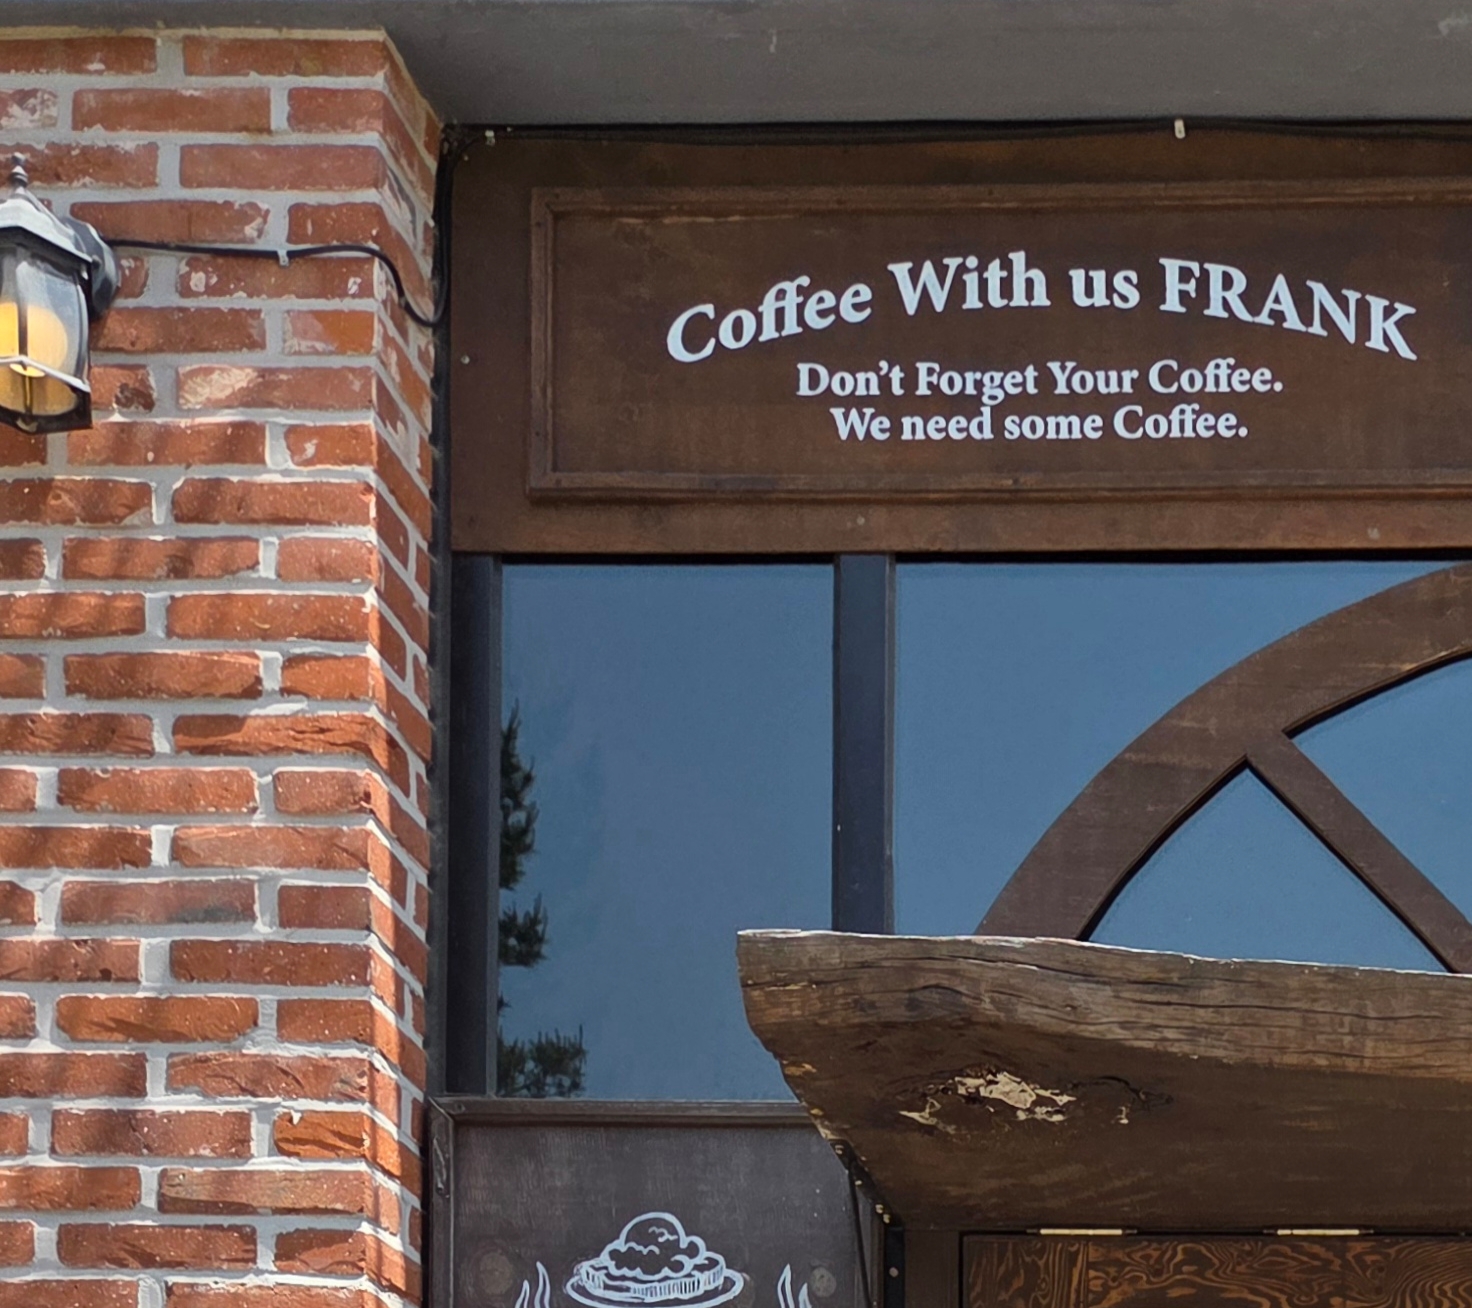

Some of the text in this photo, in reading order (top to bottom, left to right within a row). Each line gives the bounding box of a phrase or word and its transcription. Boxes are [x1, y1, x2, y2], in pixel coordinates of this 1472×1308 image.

[667, 251, 1418, 362] Coffee With us FRANK
[797, 357, 1283, 405] Don't Forget Your Coffee.
[830, 403, 1248, 441] We need some Coffee.
